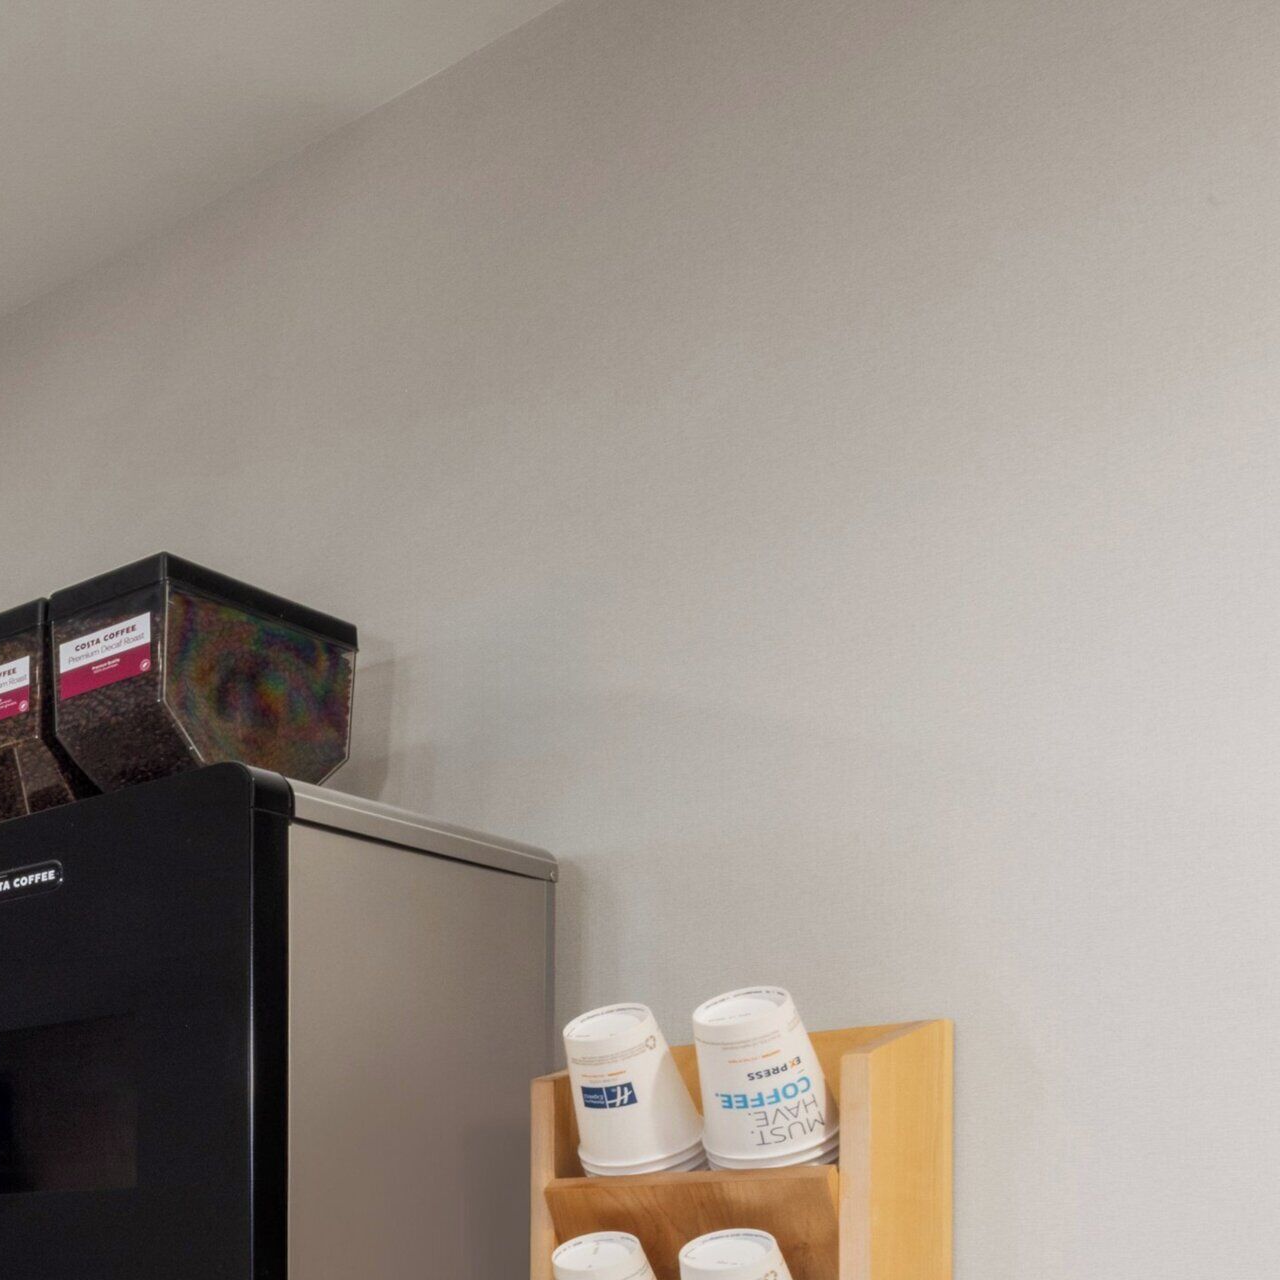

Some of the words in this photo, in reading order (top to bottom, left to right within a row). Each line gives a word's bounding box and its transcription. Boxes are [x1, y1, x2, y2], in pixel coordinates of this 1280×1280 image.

[68, 650, 100, 665] Premium
[101, 640, 122, 654] Decaf
[123, 632, 145, 644] Roast
[74, 637, 101, 652] COSTA
[103, 624, 137, 641] COFFEE
[13, 869, 56, 888] COFFEE
[715, 1076, 812, 1109] COFFEE.
[748, 1093, 819, 1129] HAVE.
[751, 1110, 826, 1146] MUST.
